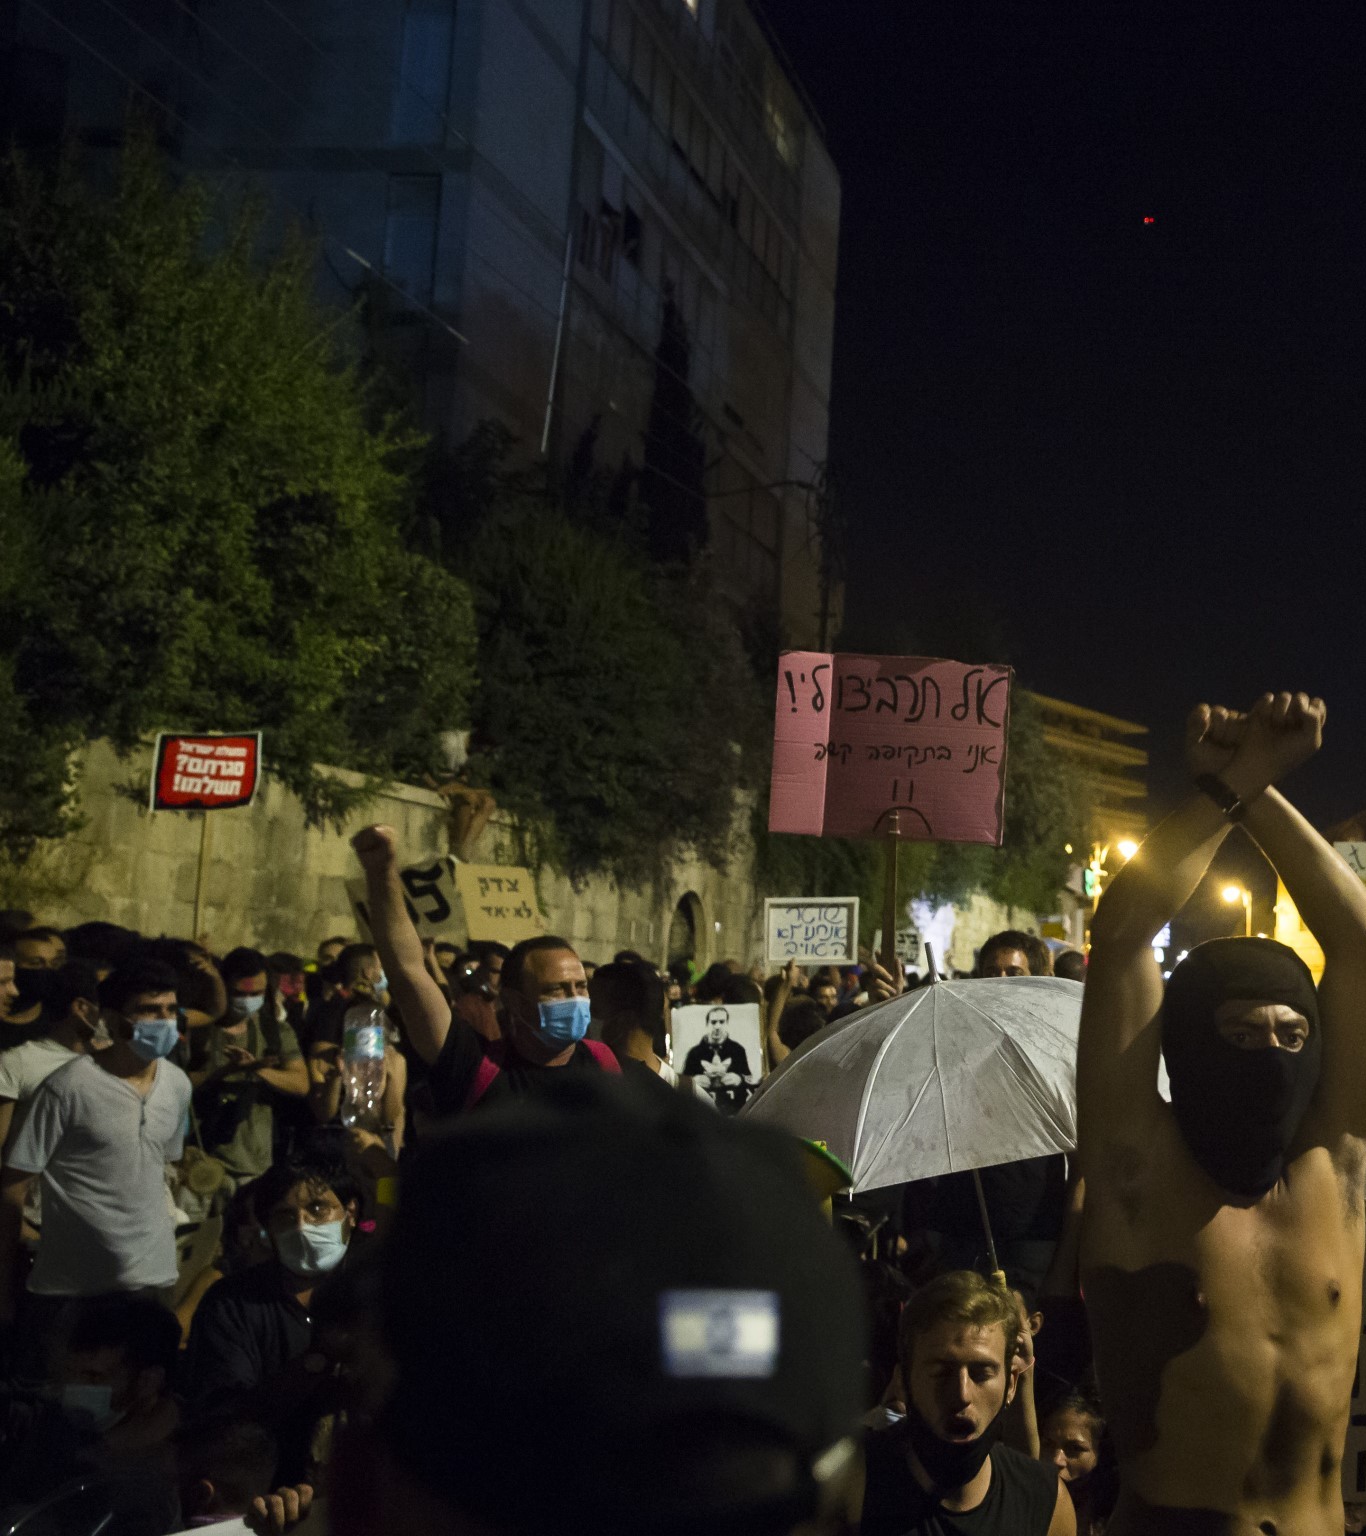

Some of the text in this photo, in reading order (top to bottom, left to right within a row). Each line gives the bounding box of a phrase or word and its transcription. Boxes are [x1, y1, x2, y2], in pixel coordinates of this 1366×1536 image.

[951, 669, 1009, 728] אל
[813, 742, 998, 773] אני בתקופה קשה
